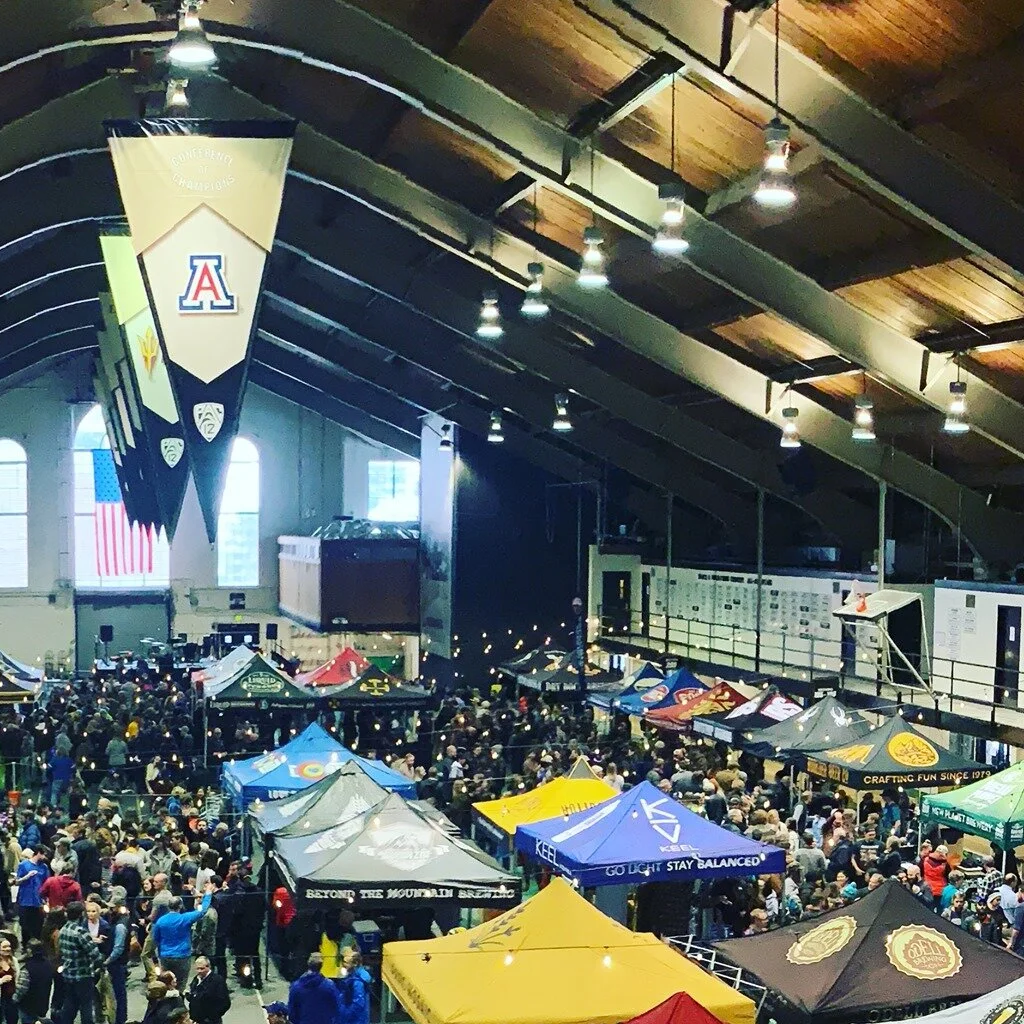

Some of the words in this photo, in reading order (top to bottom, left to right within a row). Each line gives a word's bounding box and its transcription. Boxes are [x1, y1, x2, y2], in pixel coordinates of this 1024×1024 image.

[171, 147, 233, 167] CONFERENCE
[172, 173, 235, 192] CHAMPIONS
[178, 255, 238, 313] A
[863, 774, 914, 785] CRAFTING
[917, 773, 937, 783] FUN
[940, 771, 969, 781] SINCE
[972, 770, 992, 780] 1979
[535, 838, 559, 868] KEEL
[659, 844, 700, 853] KEEL
[605, 864, 626, 877] GO
[628, 862, 663, 875] LIGHT
[666, 860, 694, 872] STAY
[696, 856, 761, 870] BALANCED
[304, 888, 356, 899] BEYOND
[359, 888, 384, 899] THE
[386, 886, 454, 899] MOUNTAIN
[457, 888, 515, 899] BREWING
[907, 939, 947, 959] ODELL
